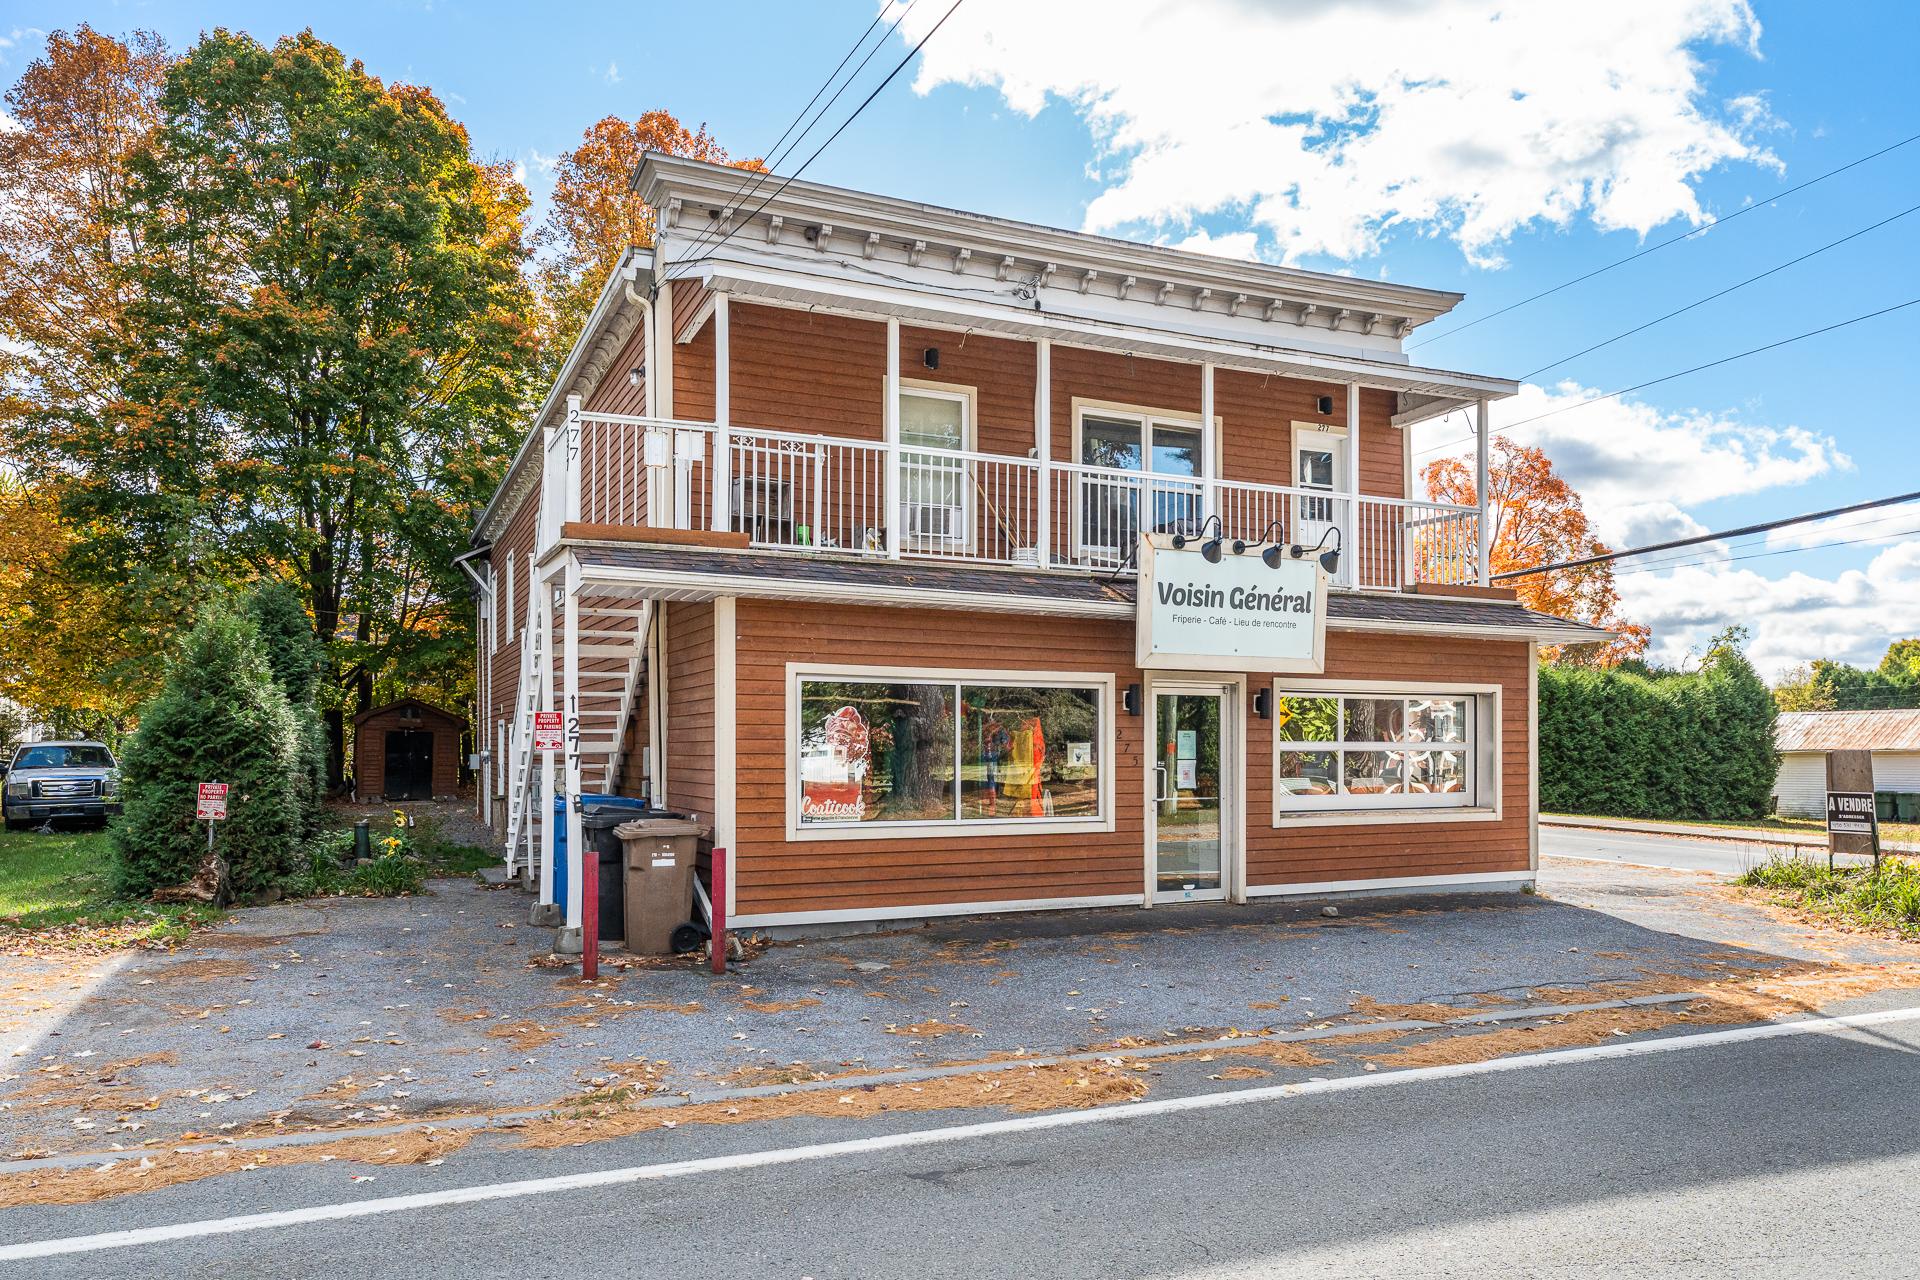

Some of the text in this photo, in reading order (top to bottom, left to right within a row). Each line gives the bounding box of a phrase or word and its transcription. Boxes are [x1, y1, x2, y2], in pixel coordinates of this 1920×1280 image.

[570, 409, 579, 461] 277
[1317, 424, 1330, 432] 277
[1157, 581, 1312, 614] Voisin Général
[1172, 614, 1202, 625] Friperie
[1208, 616, 1227, 626] Café
[1233, 618, 1250, 627] Lieu
[1251, 619, 1261, 628] de
[1262, 620, 1297, 630] rencontre
[568, 717, 580, 770] 277
[800, 795, 866, 816] Coaticook
[1829, 796, 1873, 812] A VENDRE
